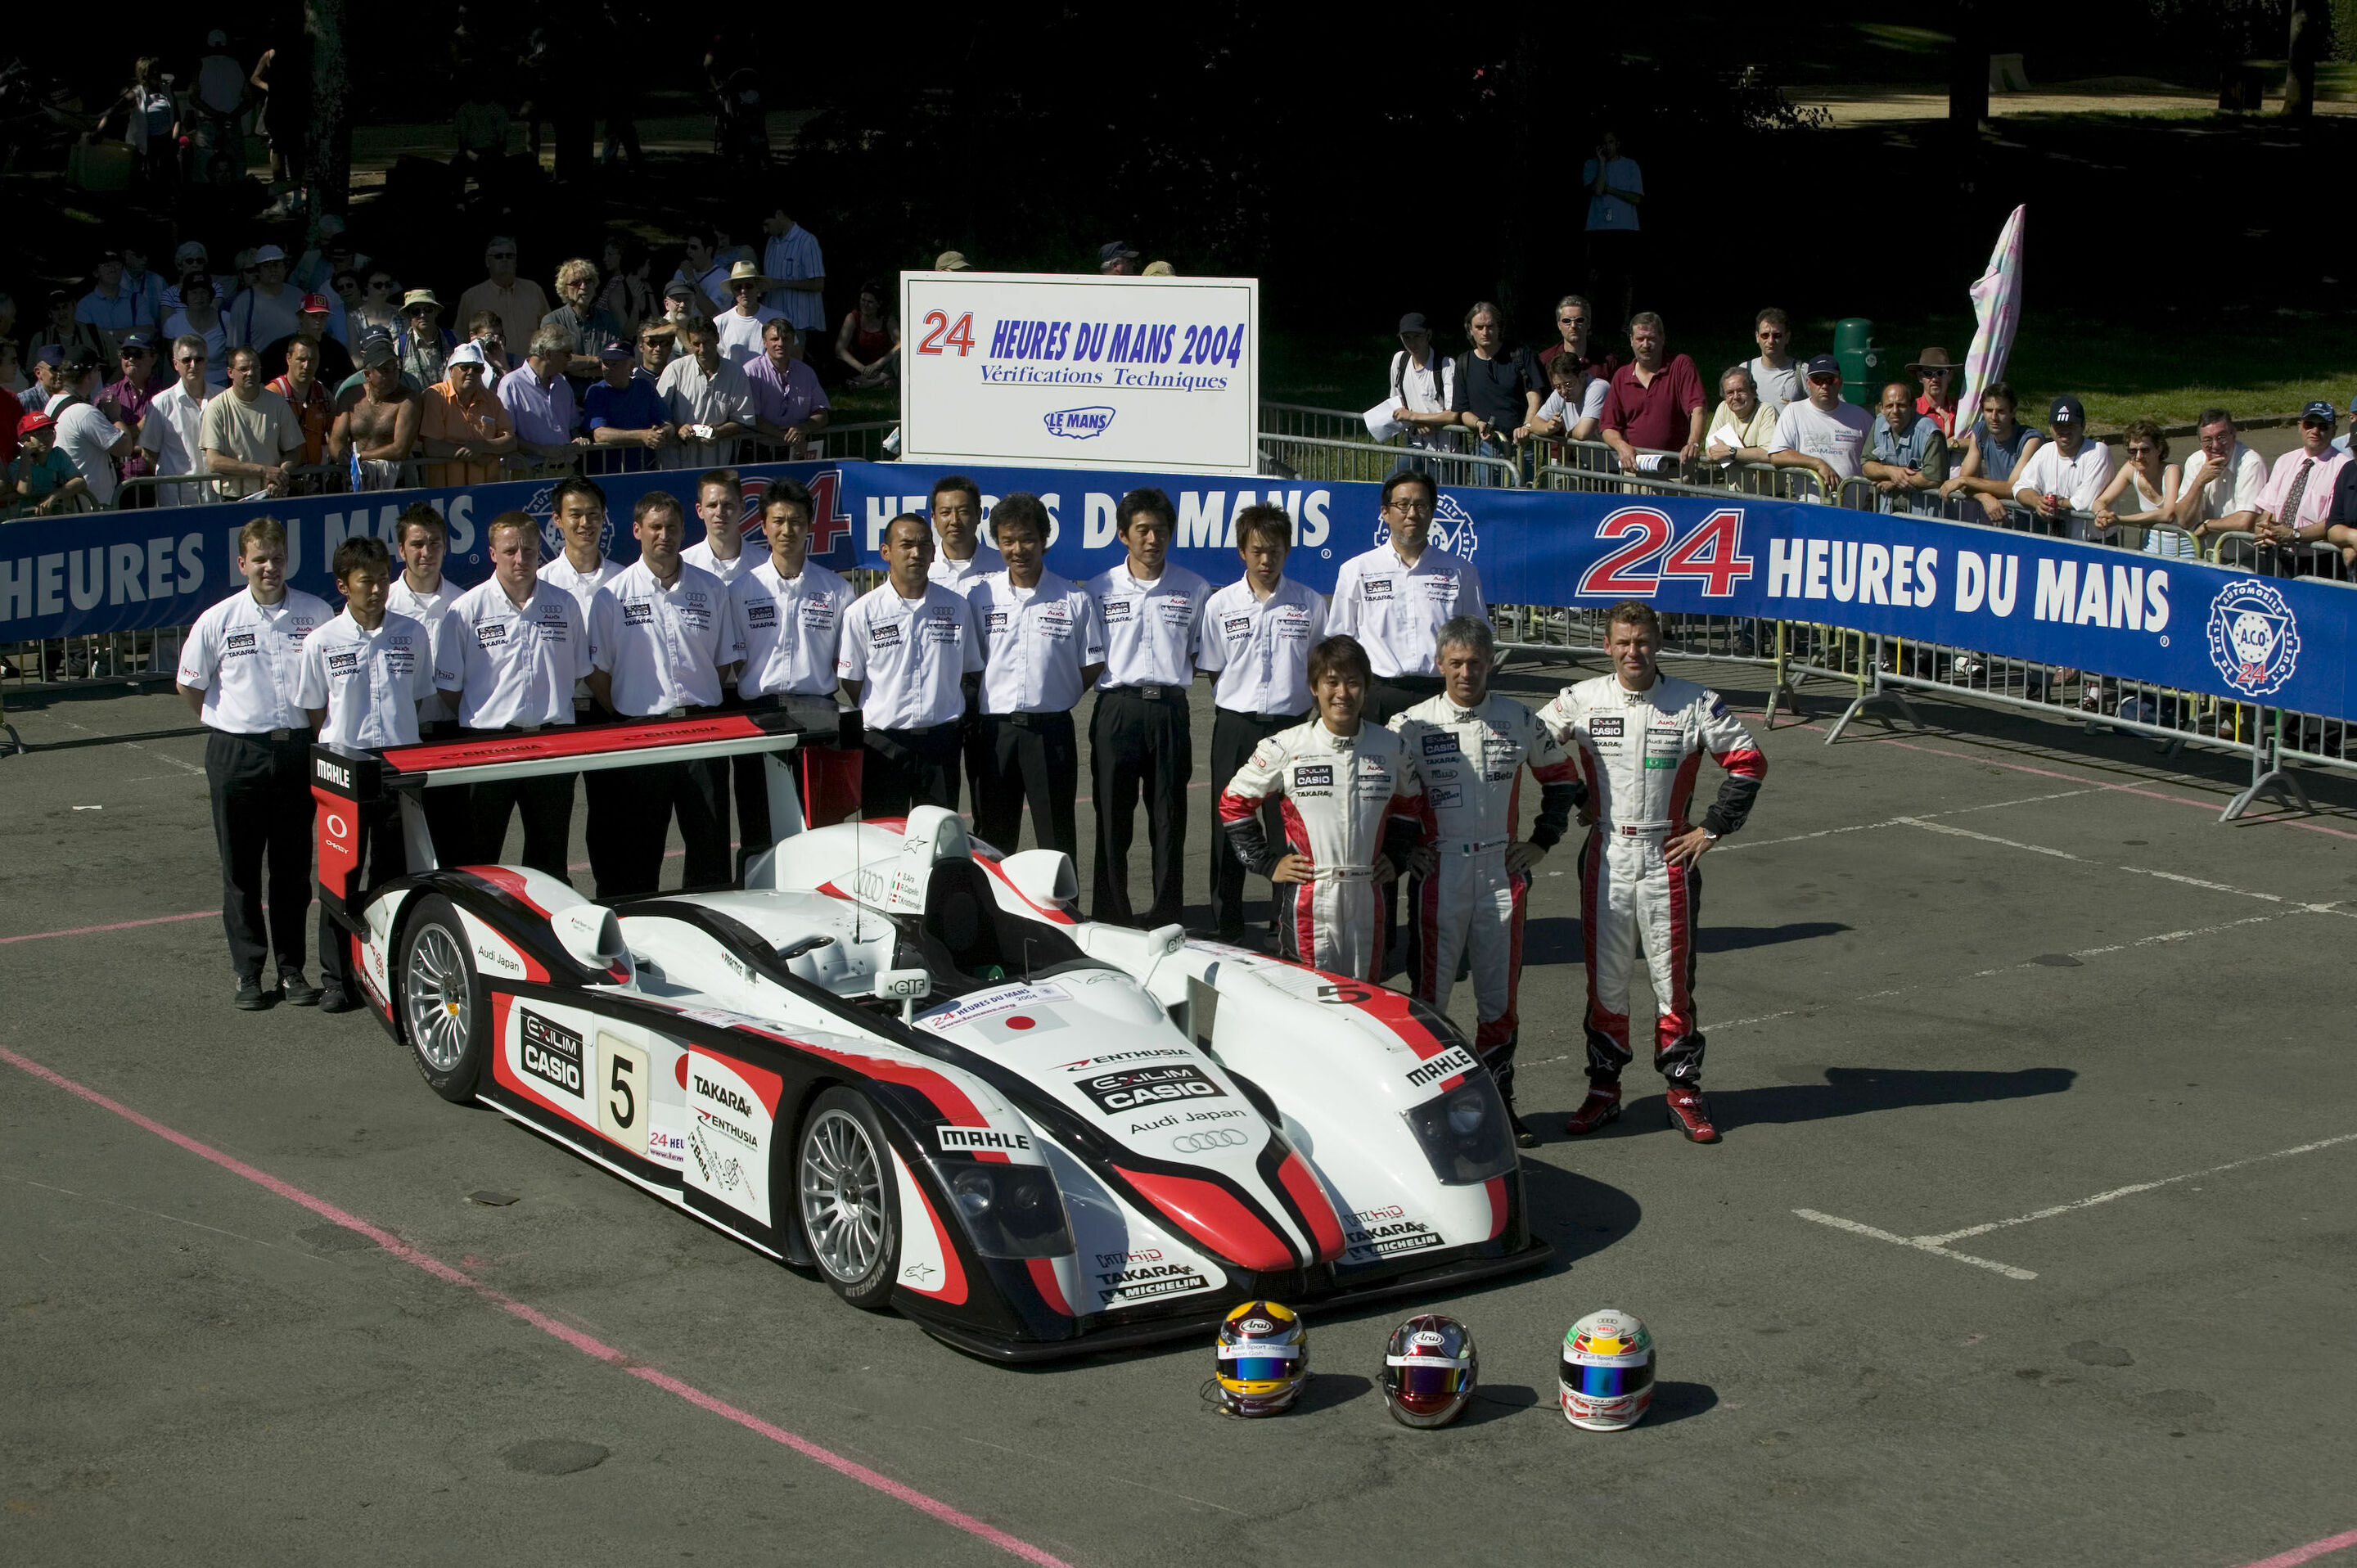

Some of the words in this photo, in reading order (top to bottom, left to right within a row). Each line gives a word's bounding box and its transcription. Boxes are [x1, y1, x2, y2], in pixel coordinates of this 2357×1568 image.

[917, 309, 976, 357] 24
[989, 320, 1072, 360] HEURES
[1072, 322, 1108, 363] DU
[1106, 323, 1176, 364] MANS
[1178, 323, 1245, 369] 2004
[981, 365, 1103, 385] Vérifications
[1114, 367, 1228, 393] Techniques
[1048, 412, 1063, 427] LE
[1066, 413, 1107, 429] MANS
[0, 533, 205, 622] HEURES
[1575, 506, 1754, 597] 24
[1767, 538, 1938, 608] HEURES
[1955, 550, 2018, 618] DU
[2034, 558, 2170, 633] MANS
[2223, 587, 2283, 614] AUTOMOBILE
[624, 619, 651, 627] TAKARA
[1227, 624, 1249, 633] CASIO
[229, 640, 254, 648] CASIO
[477, 640, 507, 649] TAKARA
[480, 631, 504, 640] CASIO
[872, 641, 899, 649] TAKARA
[874, 631, 898, 641] CASIO
[2214, 619, 2222, 653] CLUB
[228, 648, 255, 658] TAKARA
[2271, 632, 2293, 682] L'OUEST
[331, 669, 358, 678] TAKARA
[2221, 660, 2233, 675] DE
[2237, 663, 2267, 683] 24
[646, 726, 720, 738] ENTHUSIA
[461, 743, 542, 757] ENTHUSIA
[1426, 742, 1457, 753] CASIO
[1426, 757, 1456, 765] TAKARA
[317, 758, 350, 789] MAHLE
[1297, 775, 1330, 786] CASIO
[478, 945, 496, 962] Audi
[496, 953, 521, 972] Japan
[894, 979, 925, 995] elf
[1317, 984, 1372, 1005] 5
[931, 1012, 956, 1027] 24
[956, 1000, 991, 1016] HEURES
[990, 995, 1004, 1003] DU
[1004, 988, 1030, 998] MANS
[526, 1015, 578, 1056] EXILIM
[525, 1044, 580, 1090] CASIO
[1093, 1049, 1191, 1064] ENTHUSIA
[1406, 1049, 1472, 1087] MAHLE
[1093, 1069, 1193, 1090] EXILIM
[610, 1053, 634, 1129] 5
[694, 1075, 749, 1118] TAKARA
[1104, 1081, 1215, 1110] CASIO
[713, 1116, 758, 1147] ENTHUSIA
[1130, 1115, 1179, 1135] Audi
[1185, 1108, 1247, 1127] Japan
[650, 1132, 668, 1147] 24
[941, 1130, 1030, 1151] MAHLE
[693, 1145, 710, 1182] Beta
[1346, 1221, 1417, 1243] TAKARA
[1372, 1234, 1437, 1253] MICHELIN
[845, 1259, 887, 1297] MICHELIN
[1095, 1264, 1183, 1285] TAKARA
[1124, 1277, 1202, 1297] MICHELIN
[1242, 1320, 1268, 1329] Arai
